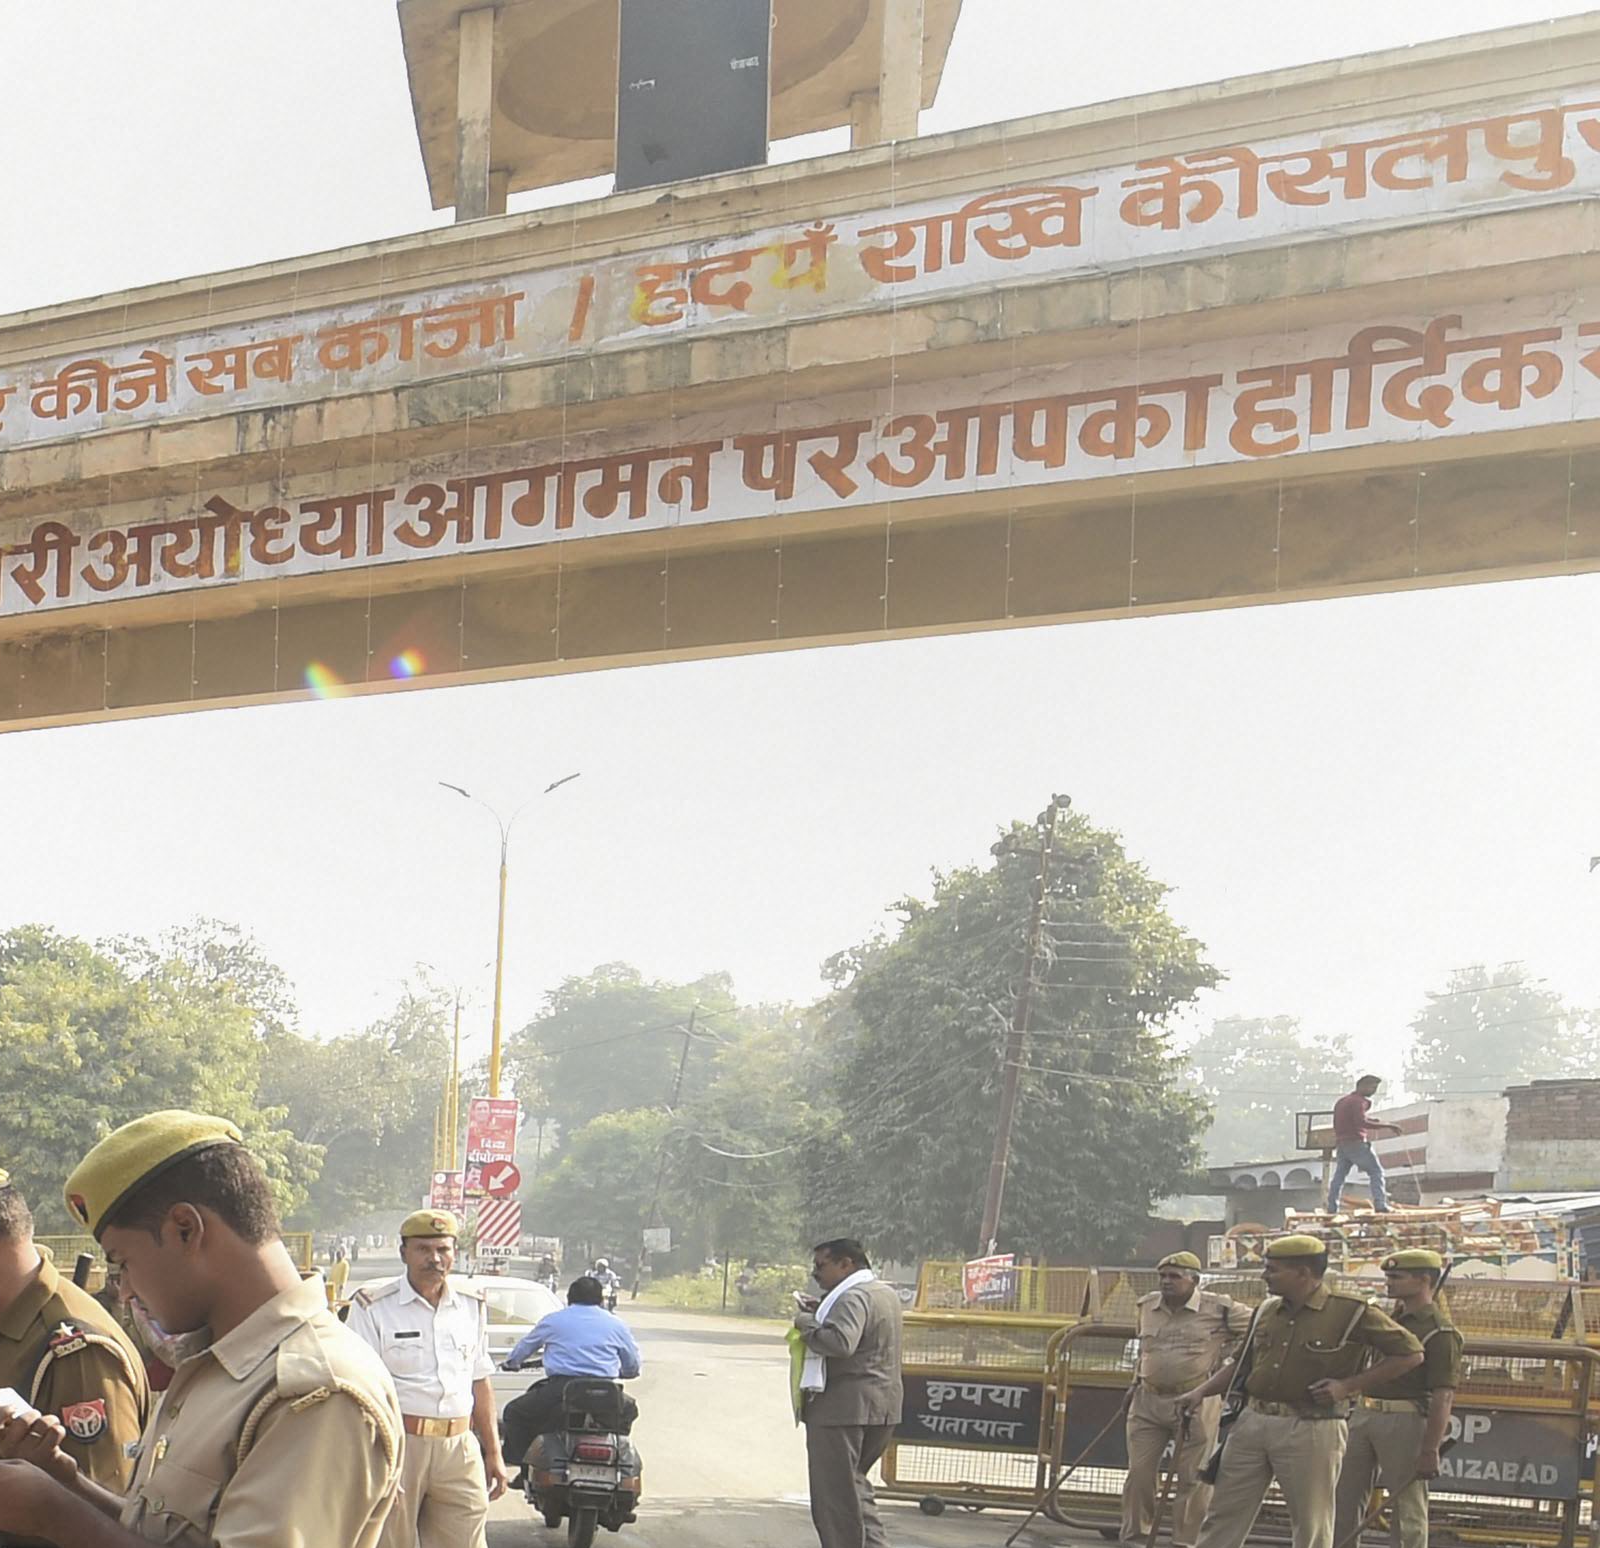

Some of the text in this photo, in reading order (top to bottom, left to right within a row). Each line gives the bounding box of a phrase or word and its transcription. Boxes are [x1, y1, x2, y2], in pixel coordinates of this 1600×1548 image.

[184, 334, 303, 396] सब
[316, 291, 526, 372] काजा
[80, 495, 397, 592] अयोध्या
[393, 440, 723, 547] आगमन
[733, 419, 873, 500] पर
[866, 375, 1223, 488] आपका
[1228, 314, 1564, 459] हार्दिक
[926, 1380, 1030, 1411] कृपया
[917, 1413, 1025, 1440] यातायात
[1439, 1457, 1559, 1486] AIZABAD
